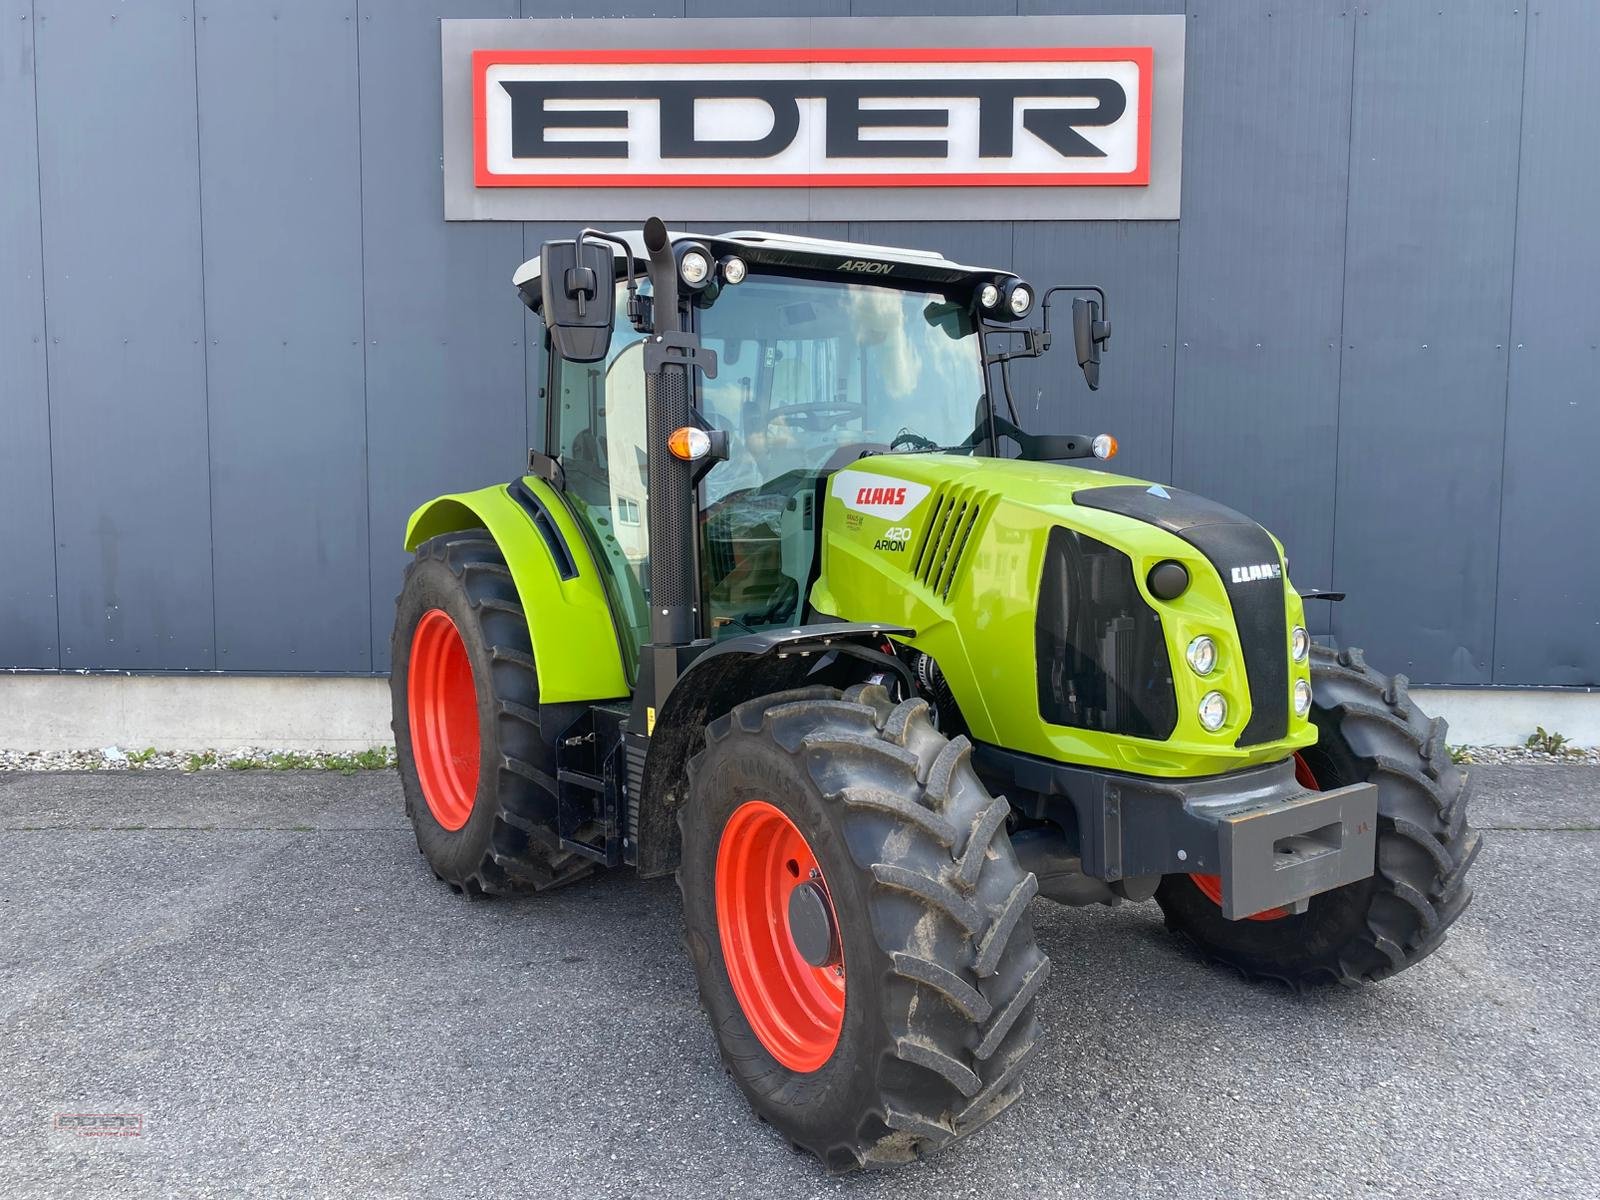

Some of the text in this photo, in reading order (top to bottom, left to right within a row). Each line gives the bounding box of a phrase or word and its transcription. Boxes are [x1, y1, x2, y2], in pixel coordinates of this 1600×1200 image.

[498, 78, 1127, 159] EDER
[837, 260, 895, 274] ARION
[856, 488, 906, 504] CLAAS
[884, 527, 912, 540] 420
[873, 540, 906, 552] ARION
[1231, 563, 1281, 583] CLAAS
